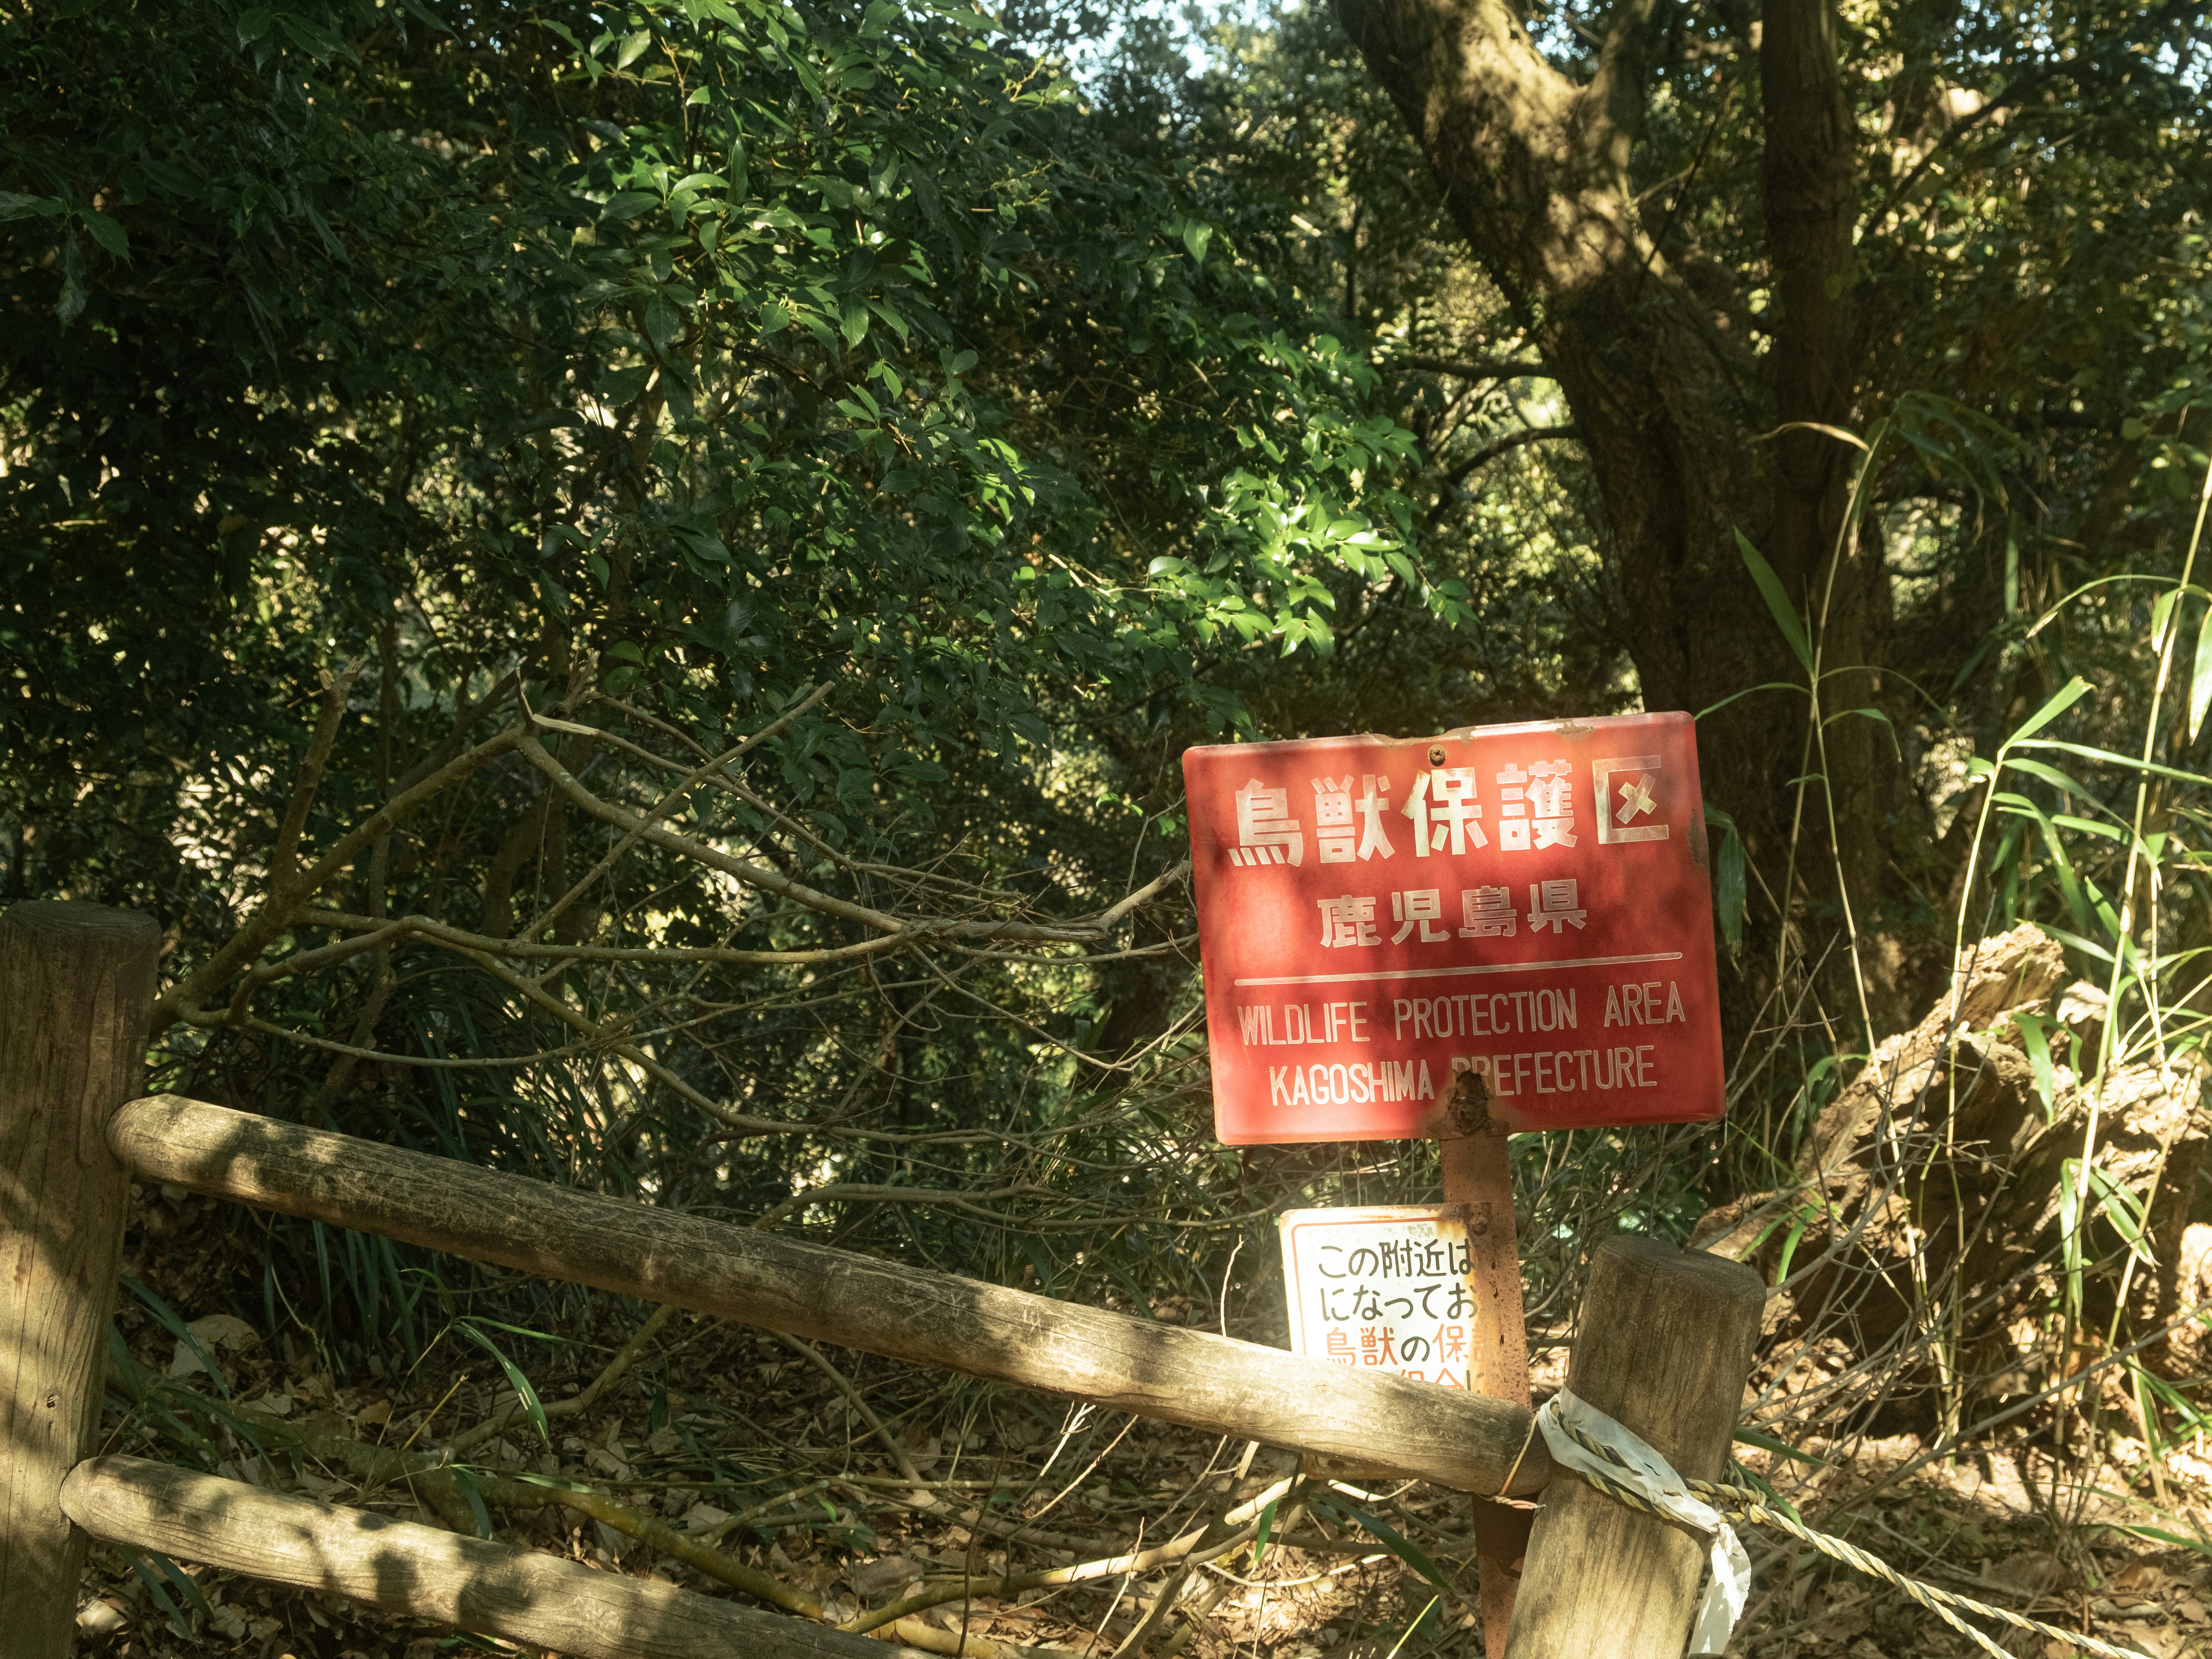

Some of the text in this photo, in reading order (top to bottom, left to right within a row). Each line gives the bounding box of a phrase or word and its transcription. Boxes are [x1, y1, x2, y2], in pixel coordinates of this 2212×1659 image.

[1227, 754, 1669, 867] 鳥獣保護区
[1316, 879, 1587, 949] 鹿児島県
[1237, 981, 1686, 1046] WILDLIFE PROTECTION AREA
[1269, 1059, 1435, 1107] KAGOSHIMA
[1319, 1238, 1474, 1278] この附近は
